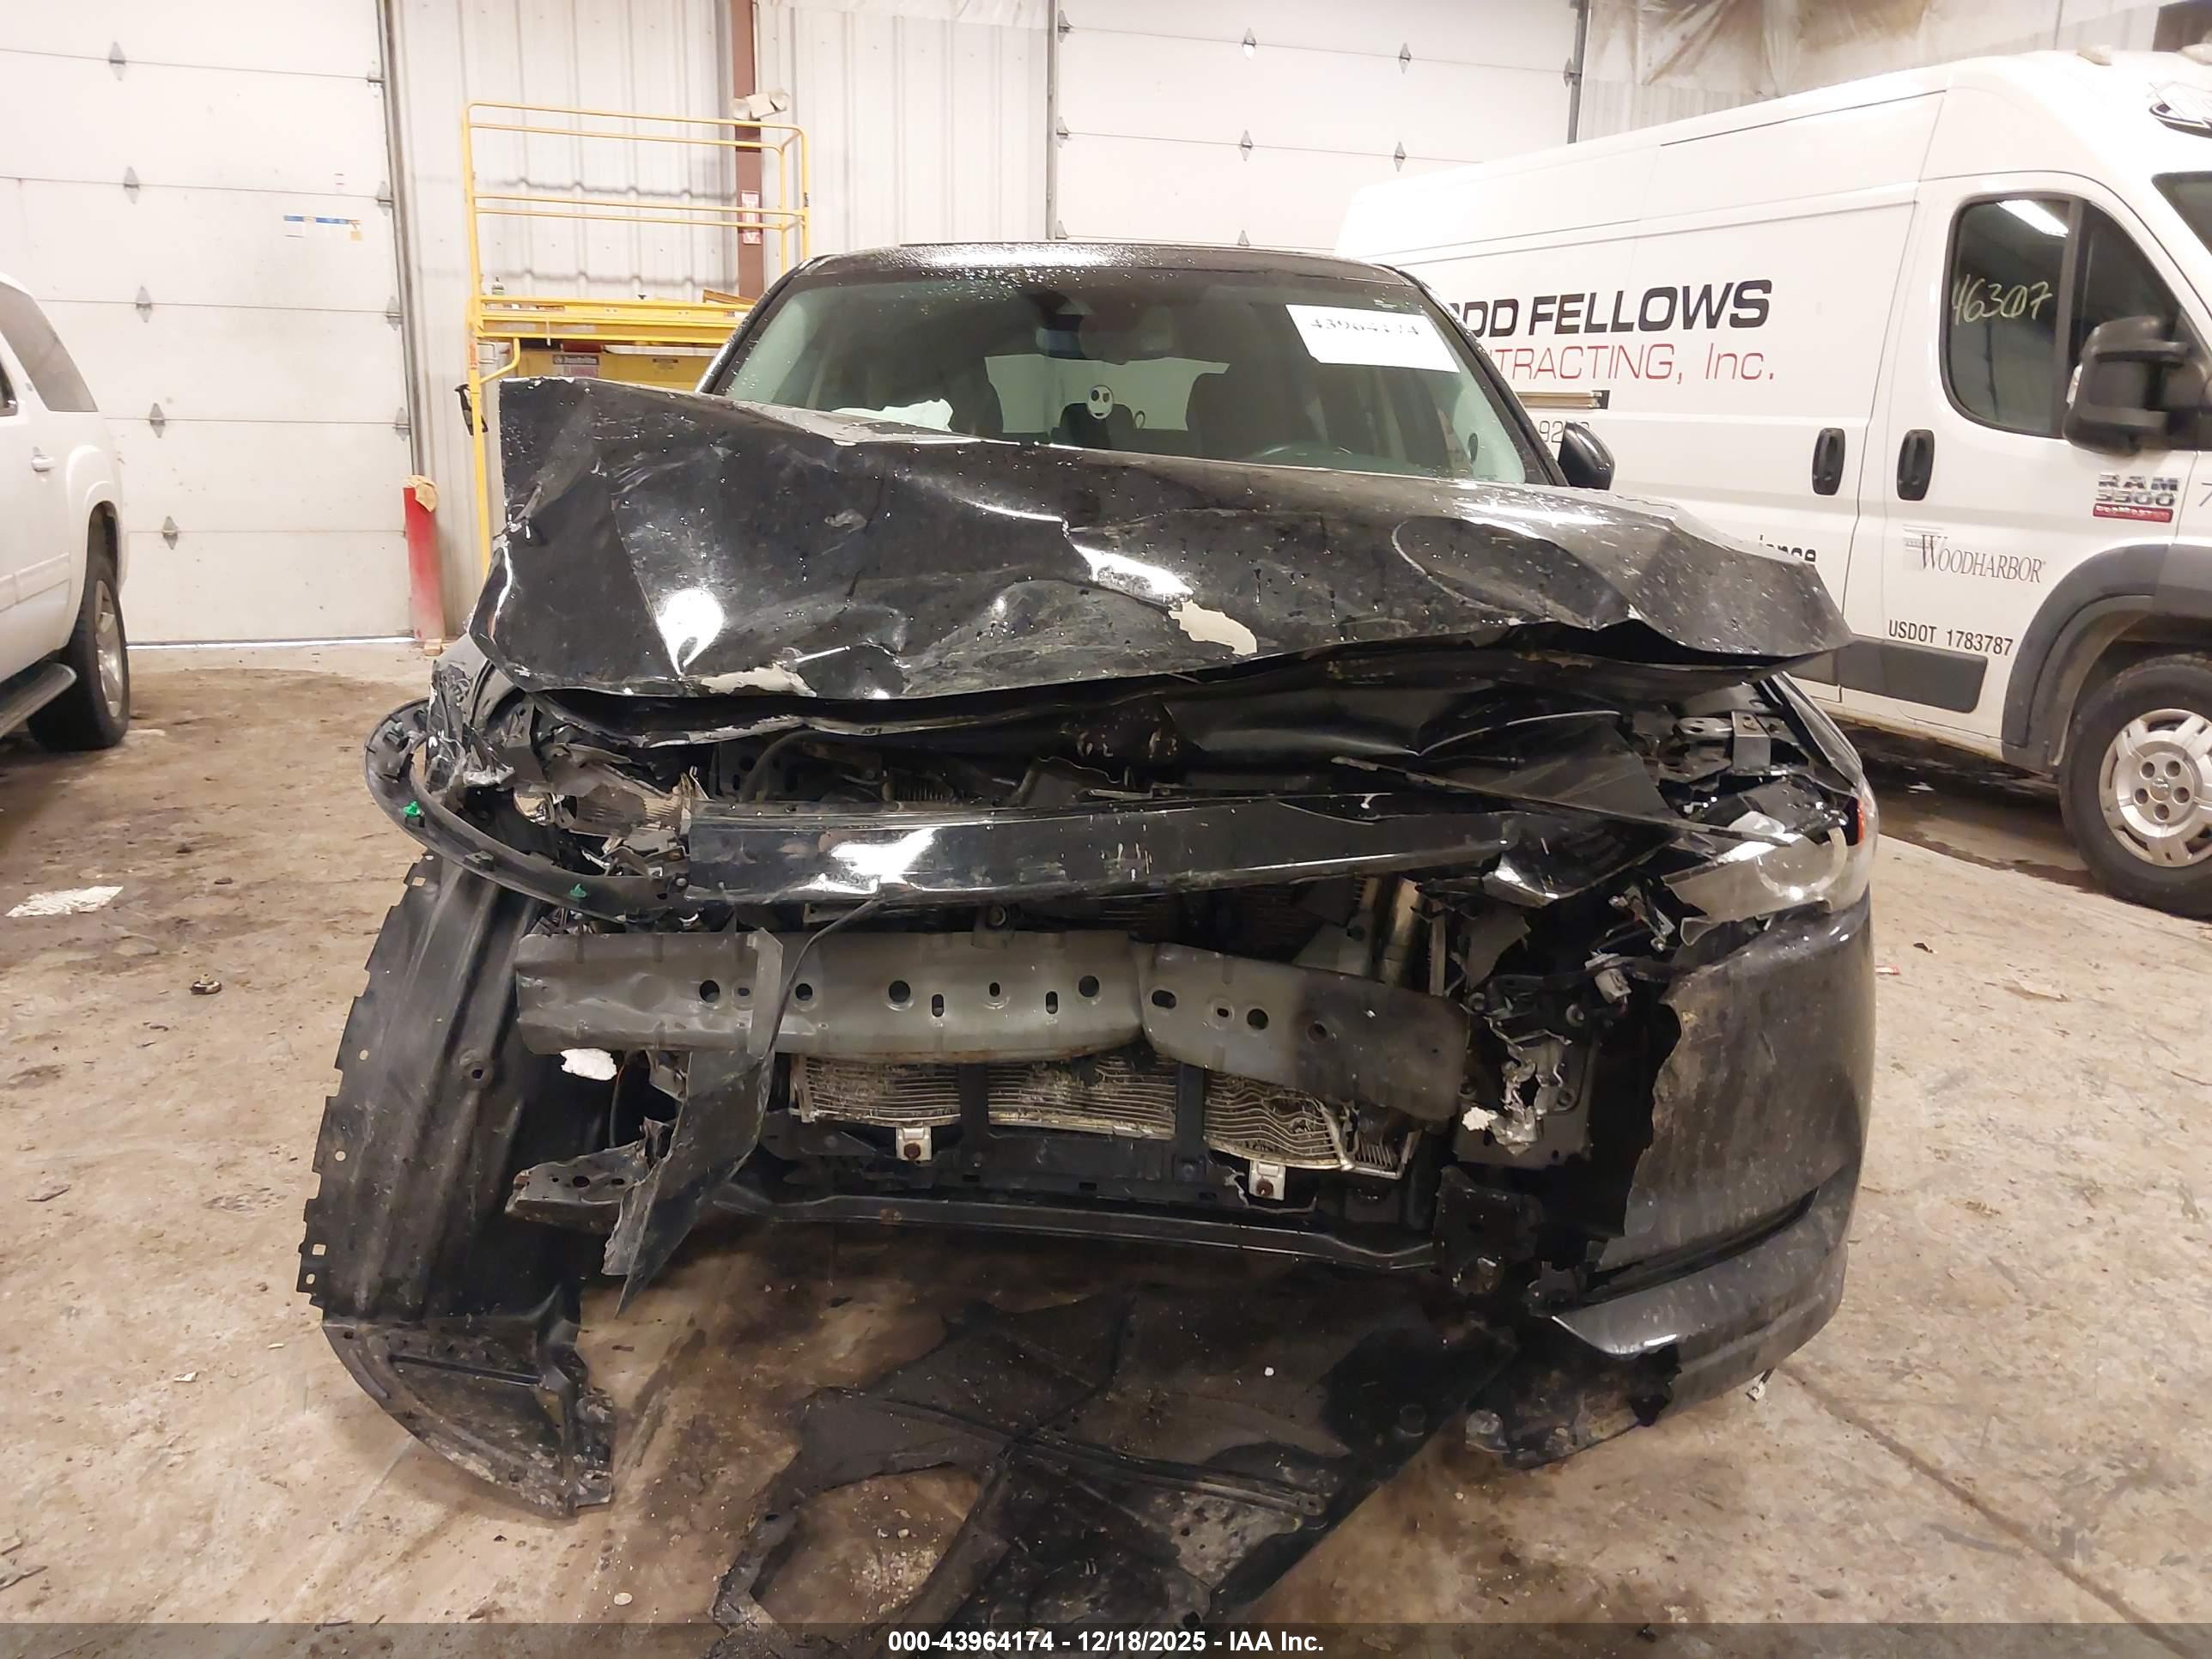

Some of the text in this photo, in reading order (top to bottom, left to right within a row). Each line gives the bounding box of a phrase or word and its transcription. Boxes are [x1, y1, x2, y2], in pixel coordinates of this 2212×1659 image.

[1528, 279, 1772, 336] FELLOWS
[1952, 273, 2053, 325] 46307
[1488, 343, 1775, 385] TRACTING, Inc.
[2098, 472, 2179, 491] RAM
[1889, 618, 2014, 657] USDOT 1783787
